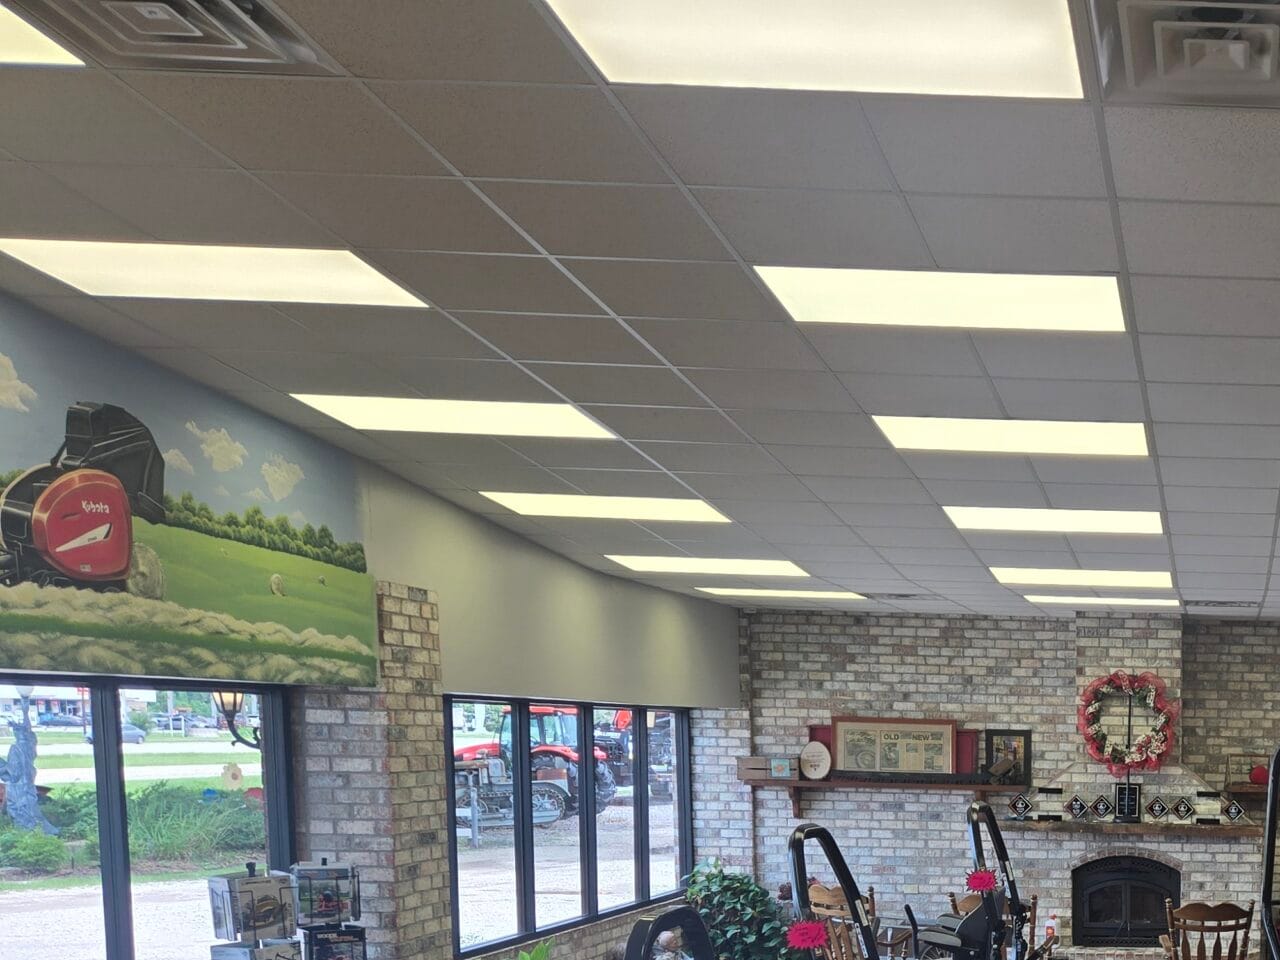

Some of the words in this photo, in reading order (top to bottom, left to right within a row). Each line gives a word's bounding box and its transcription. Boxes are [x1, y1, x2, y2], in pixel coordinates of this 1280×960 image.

[81, 500, 110, 514] Kubota
[883, 733, 900, 741] OLD
[912, 733, 930, 742] NEW
